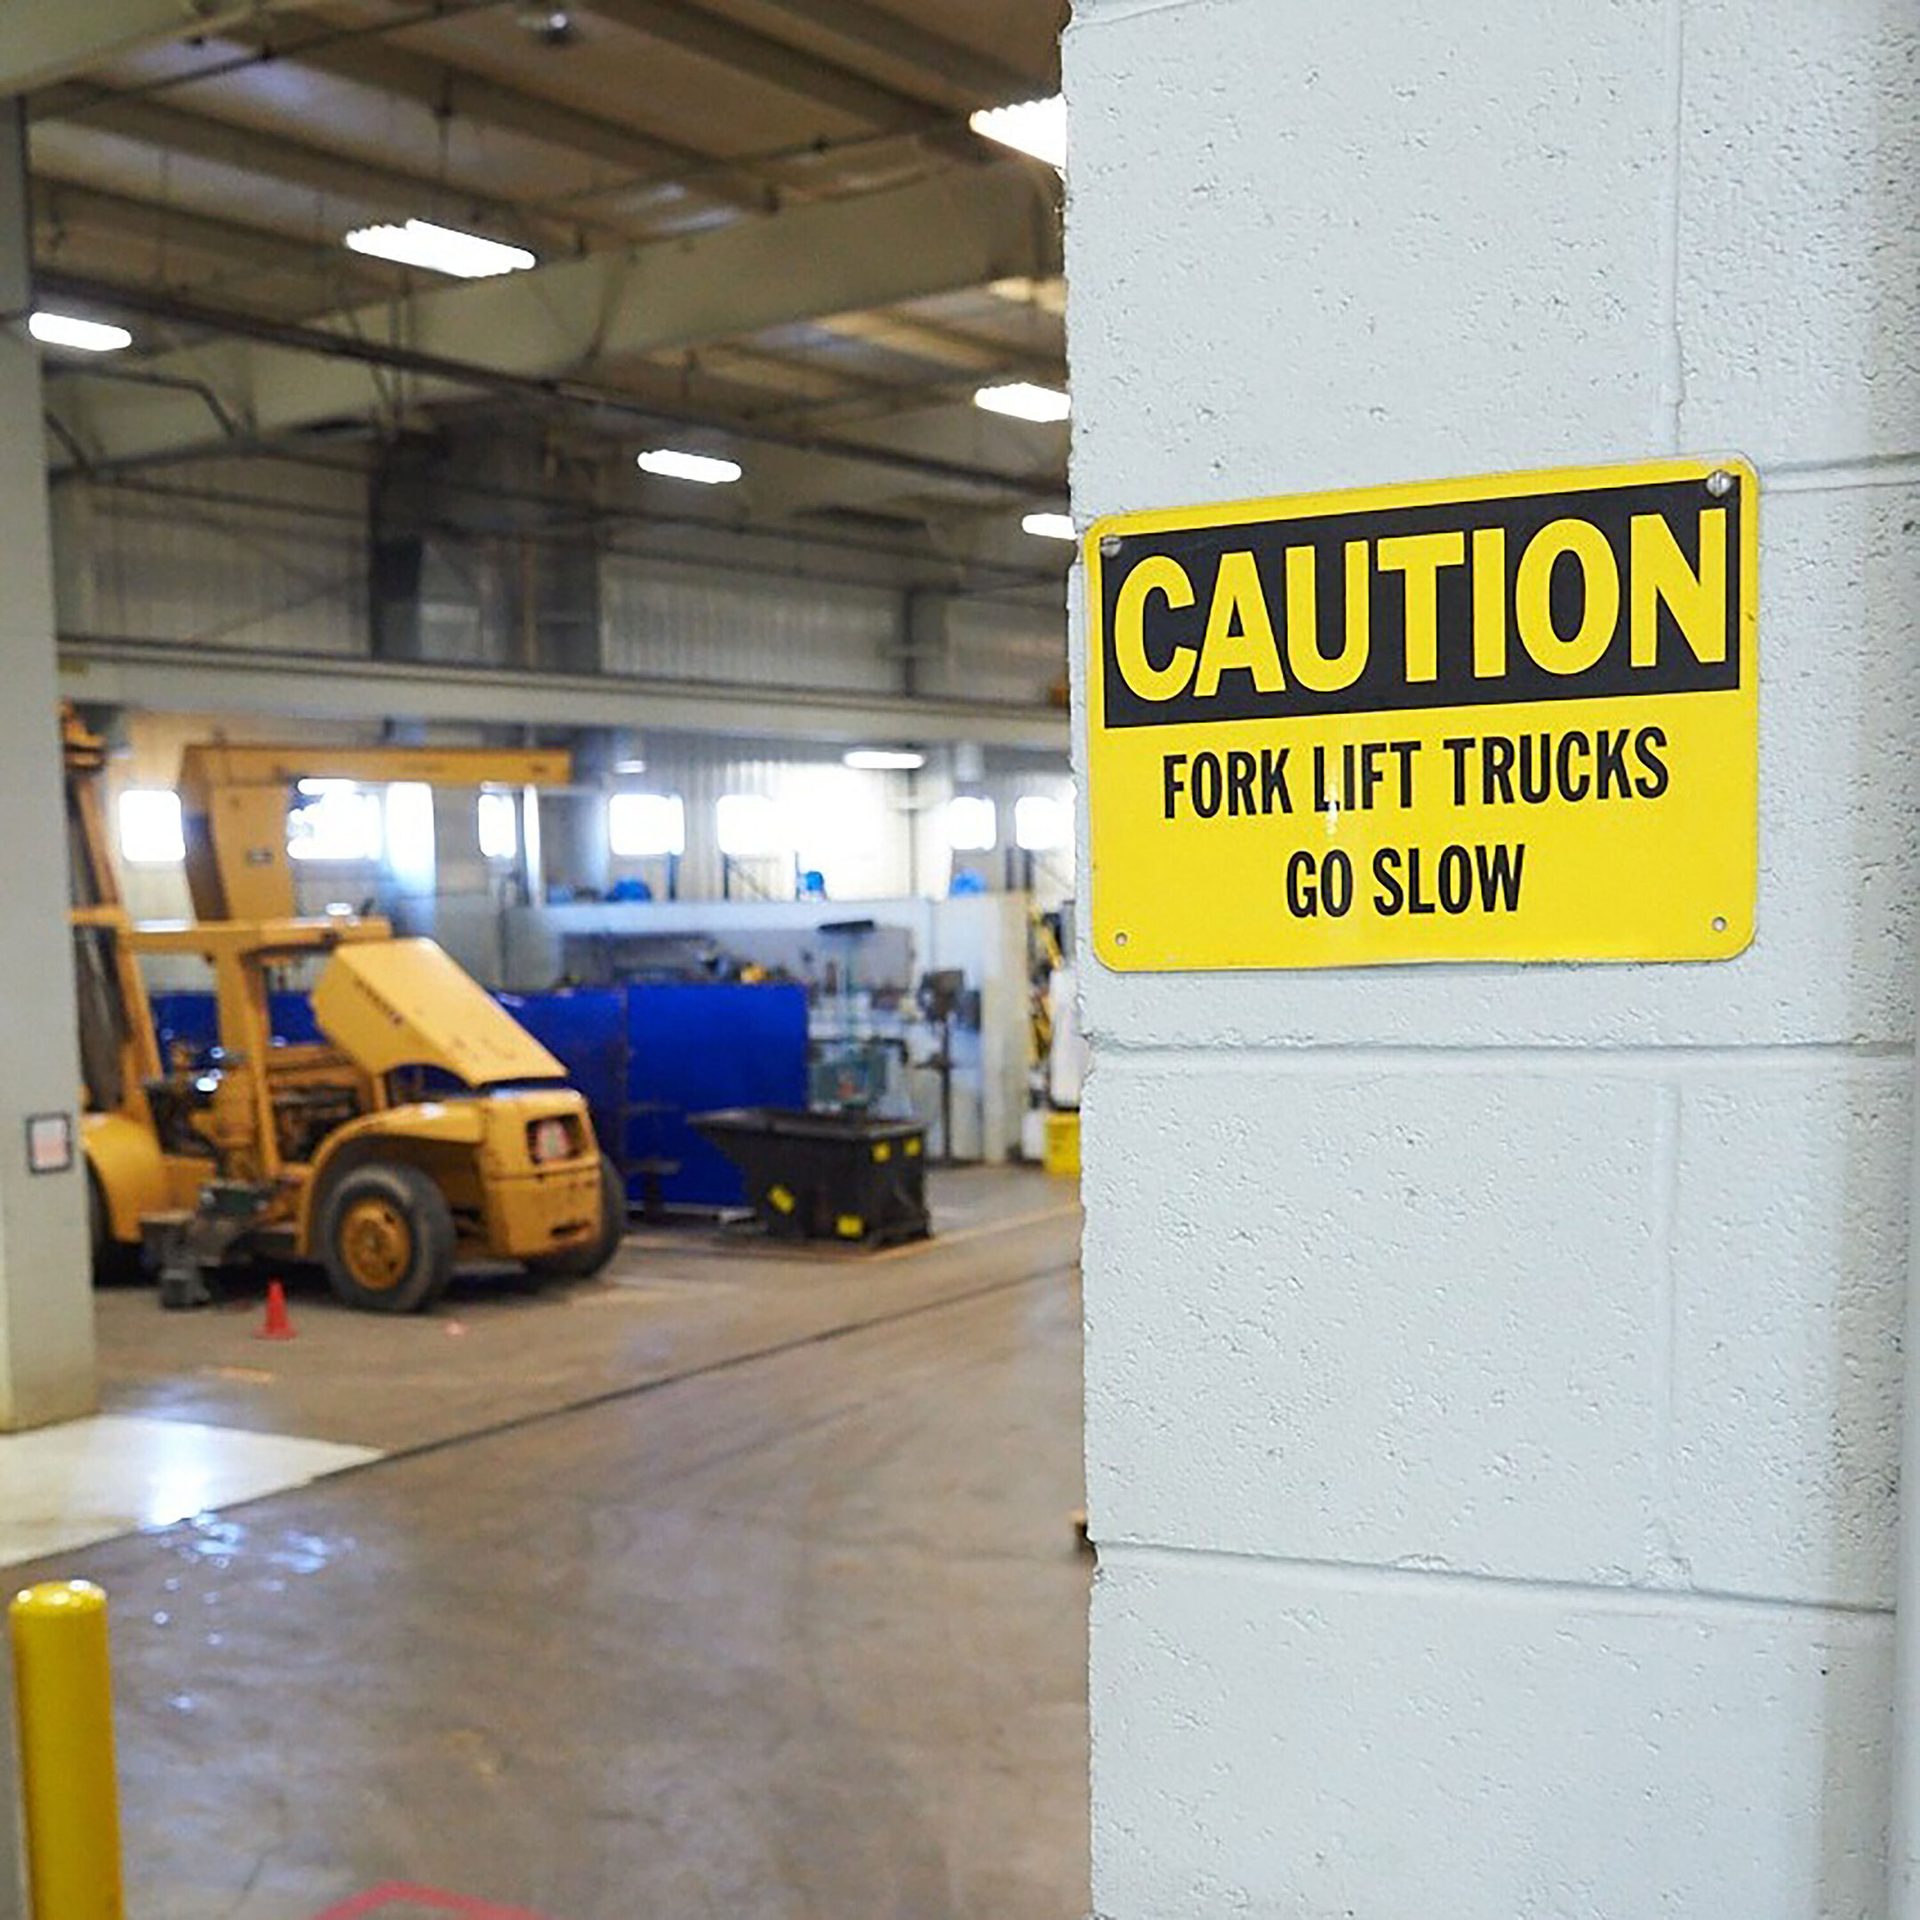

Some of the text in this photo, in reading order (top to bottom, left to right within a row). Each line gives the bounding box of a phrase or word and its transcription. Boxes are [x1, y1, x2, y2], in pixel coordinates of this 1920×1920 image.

[1114, 507, 1727, 702] CAUTION
[1162, 726, 1669, 819] FORK LIFT TRUCKS
[1286, 843, 1525, 918] GO SLOW
